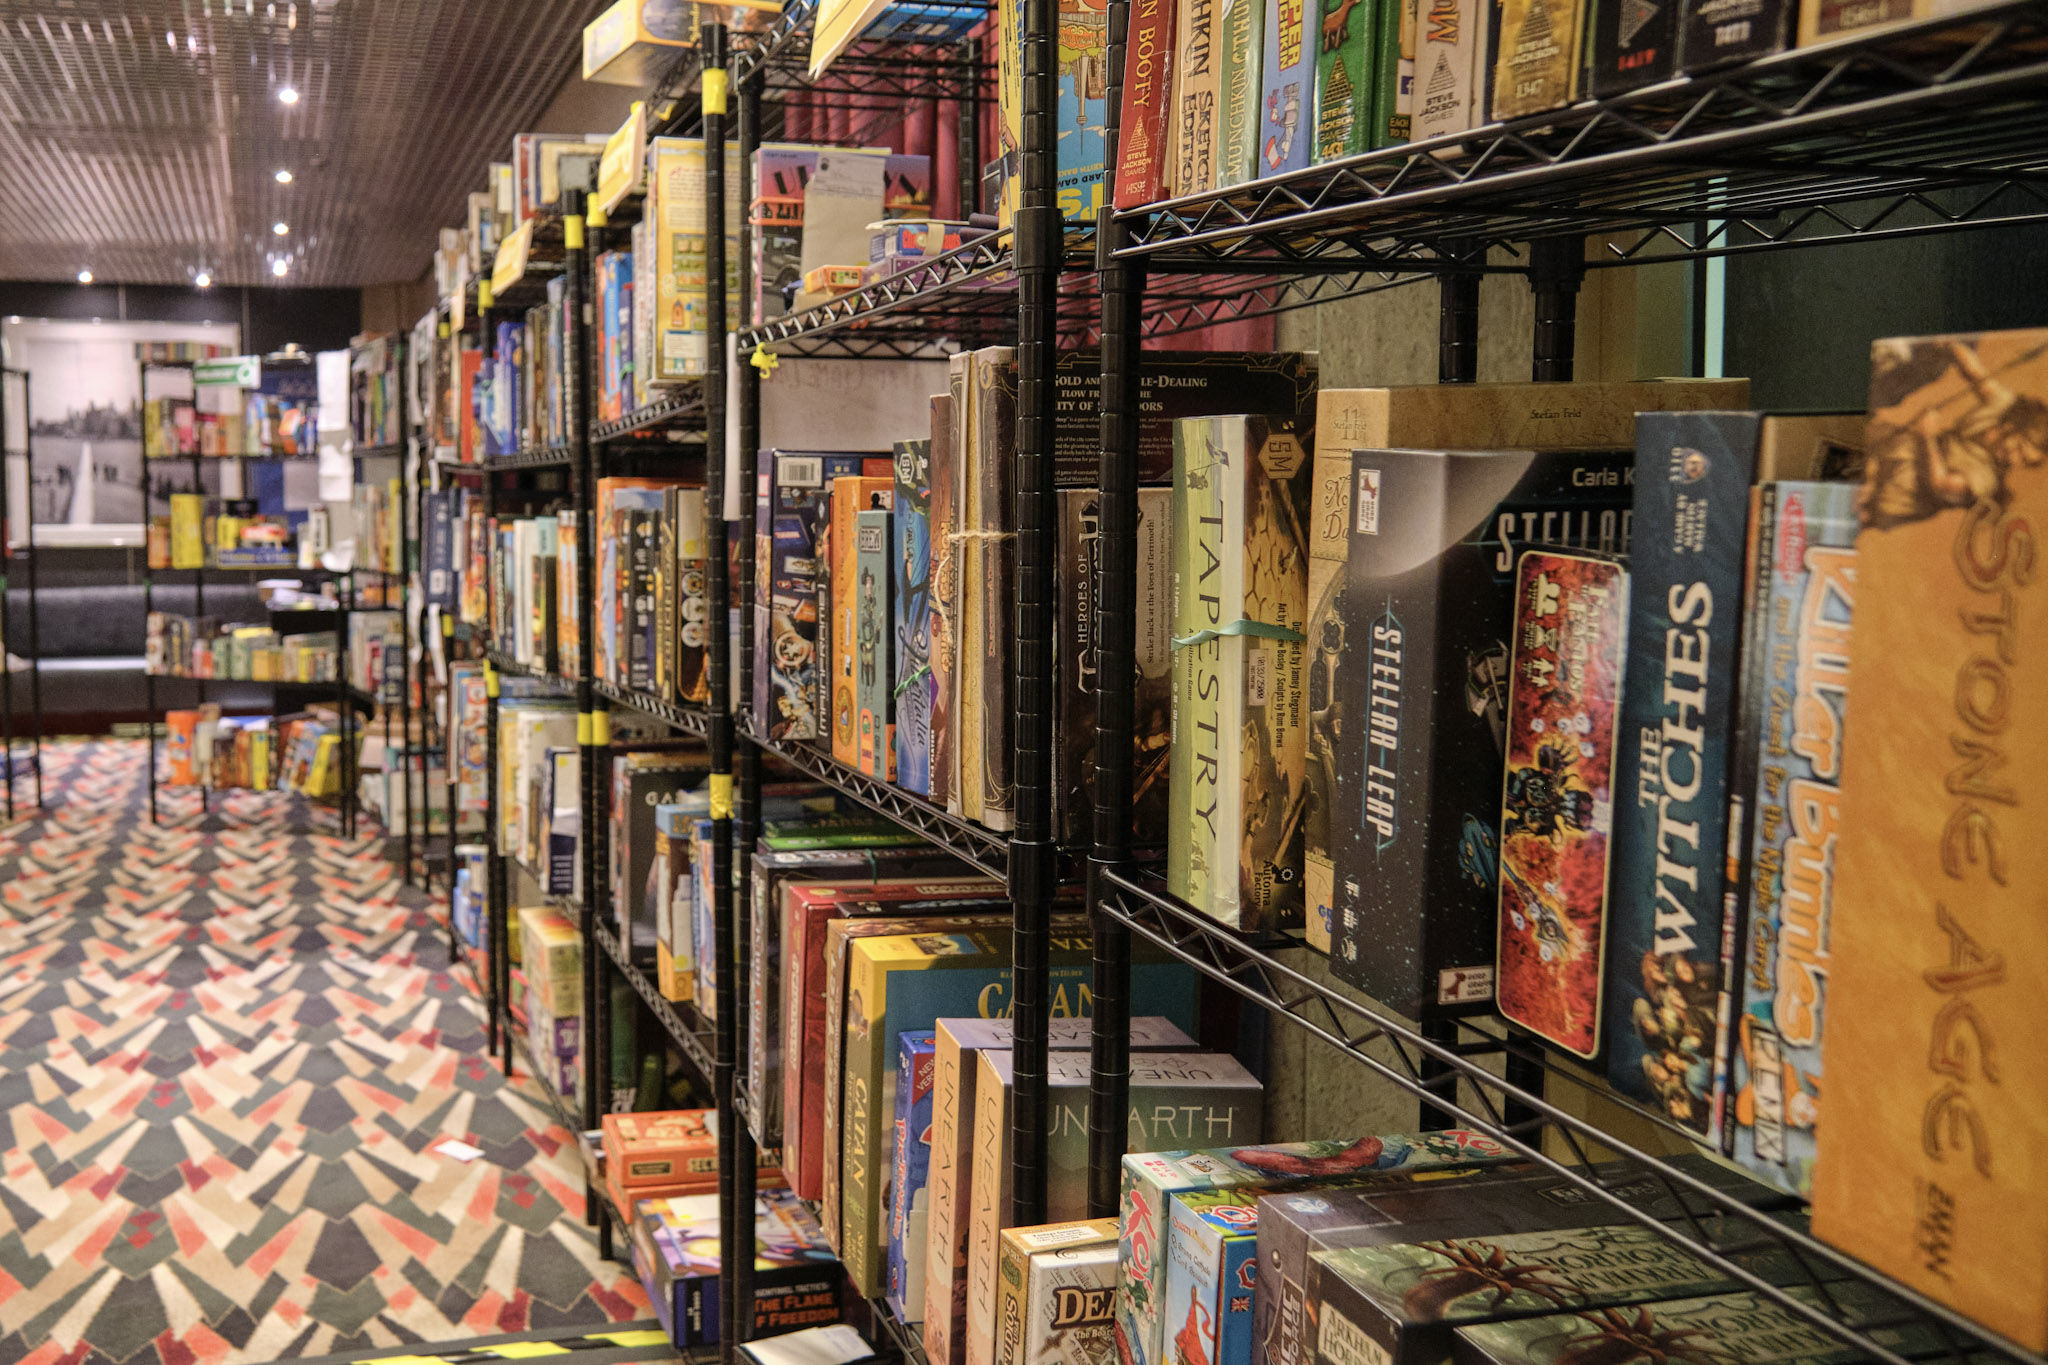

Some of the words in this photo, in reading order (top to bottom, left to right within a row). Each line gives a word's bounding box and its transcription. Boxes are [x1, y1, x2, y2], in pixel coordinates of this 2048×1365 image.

[1134, 25, 1156, 107] BOOTY
[1227, 70, 1249, 177] MUNCHKIN
[1419, 100, 1461, 116] JACKSON
[1426, 92, 1454, 105] STEVE
[1122, 158, 1152, 170] JACKSON
[1127, 151, 1147, 161] STEVE
[1056, 401, 1077, 412] ITY
[1079, 401, 1093, 412] OF
[1061, 390, 1087, 399] FLOW
[1572, 467, 1618, 487] Carla
[1077, 553, 1089, 575] OF
[1077, 580, 1089, 643] HEROES
[1195, 499, 1224, 842] TAPESTRY
[1290, 666, 1301, 689] Jamey
[1369, 625, 1401, 750] STELLAR
[1940, 499, 2037, 888] STONE
[1288, 690, 1300, 728] Stegmaier
[1639, 726, 1661, 809] THE
[1655, 580, 1714, 958] WITCHES
[1366, 764, 1395, 837] LEAP
[1253, 872, 1264, 907] Factory
[1262, 860, 1273, 907] Automa
[1922, 901, 2007, 1180] AGE
[853, 1075, 867, 1189] CATAN
[938, 1060, 955, 1266] UNEARTH
[979, 1096, 998, 1314] UNEARTH
[783, 1293, 833, 1309] FLAME
[1326, 1309, 1384, 1363] ARKHAM
